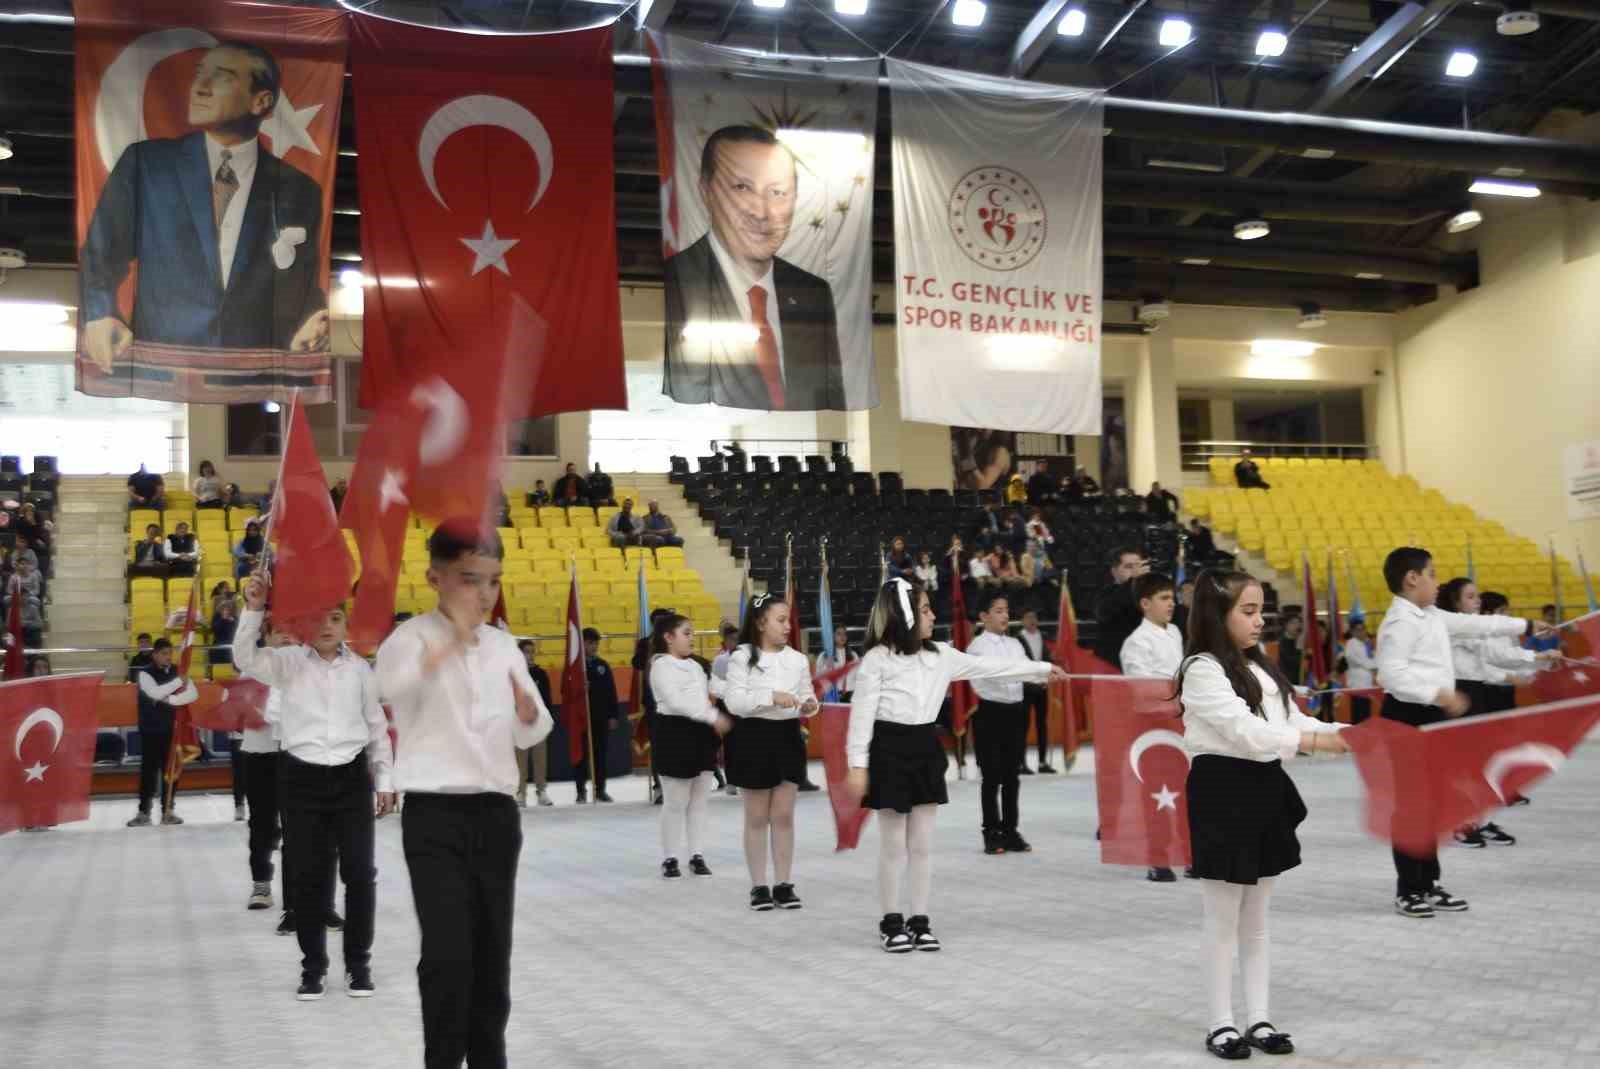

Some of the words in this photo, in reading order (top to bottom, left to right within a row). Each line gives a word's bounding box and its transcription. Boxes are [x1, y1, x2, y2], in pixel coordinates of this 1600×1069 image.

[904, 276, 944, 298] T.C.
[951, 282, 1056, 312] GENÇLİK
[1065, 293, 1093, 314] VE
[904, 306, 962, 331] SPOR
